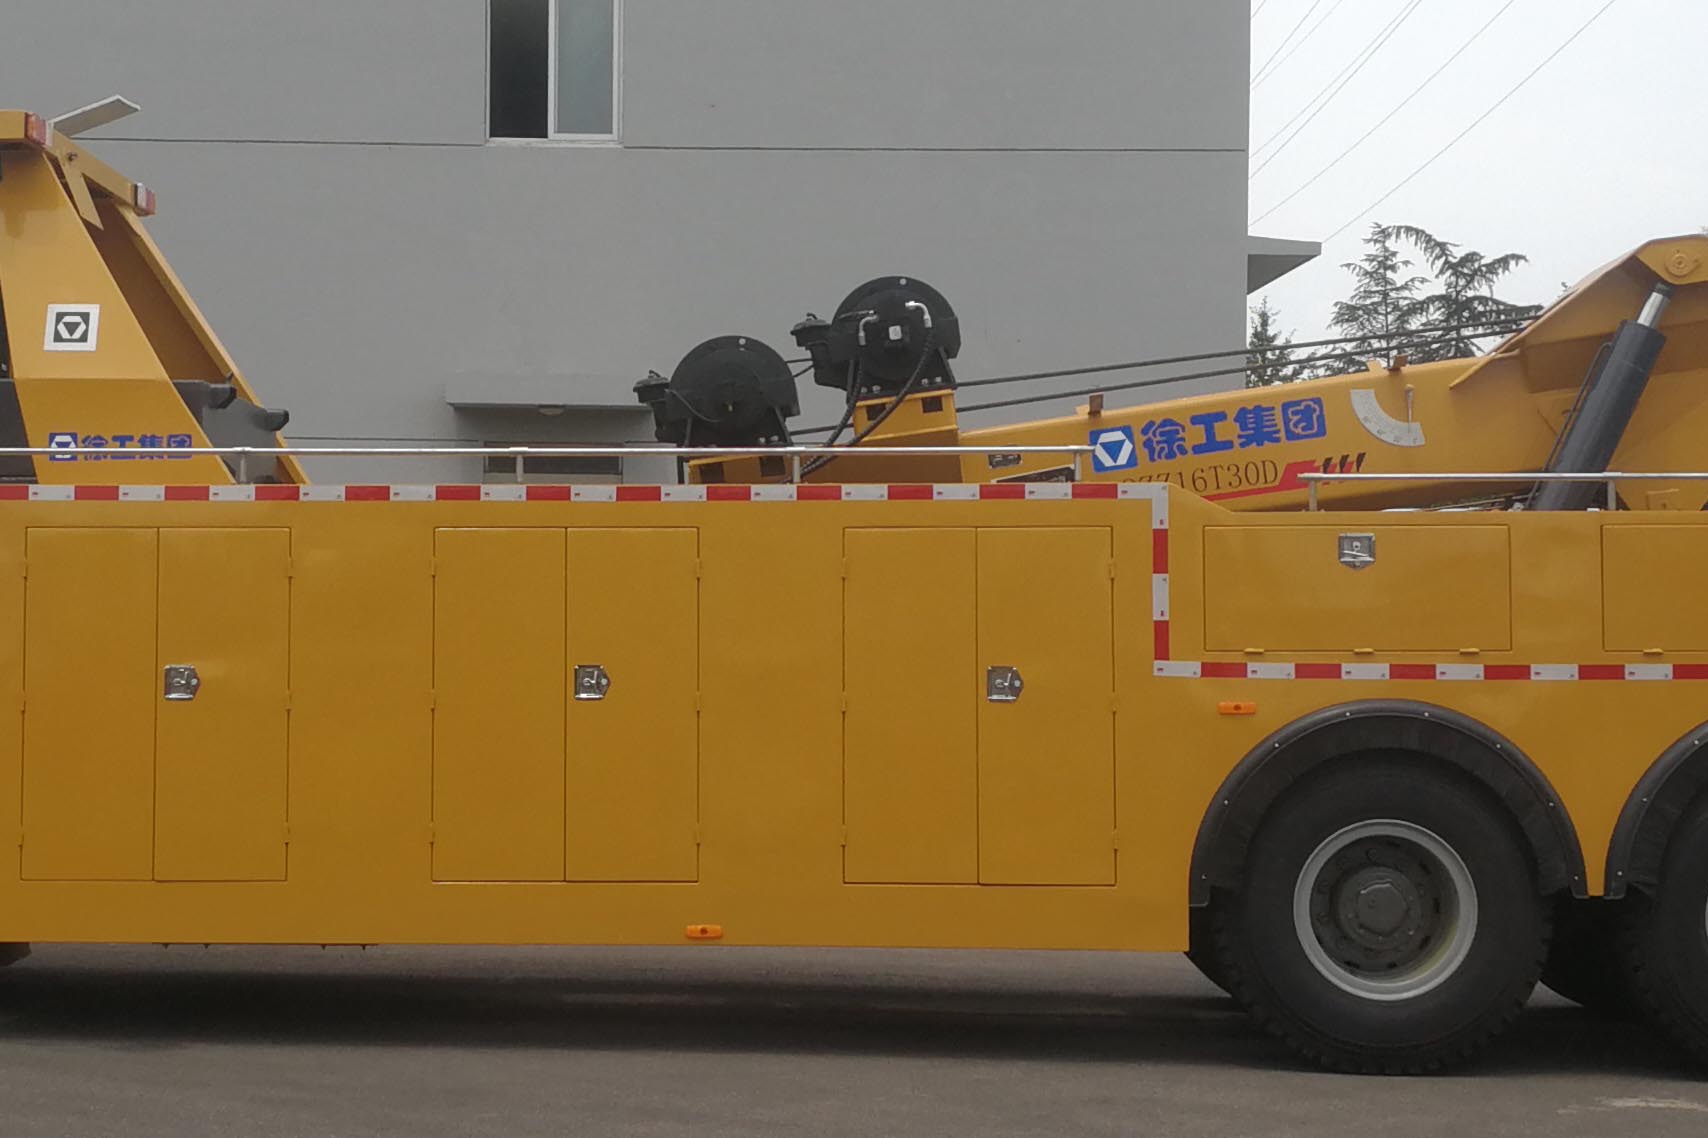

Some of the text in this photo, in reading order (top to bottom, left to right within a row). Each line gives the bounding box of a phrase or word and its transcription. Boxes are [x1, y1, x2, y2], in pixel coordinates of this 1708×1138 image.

[81, 434, 192, 461] 徐工集团
[1140, 397, 1327, 462] 徐工集团
